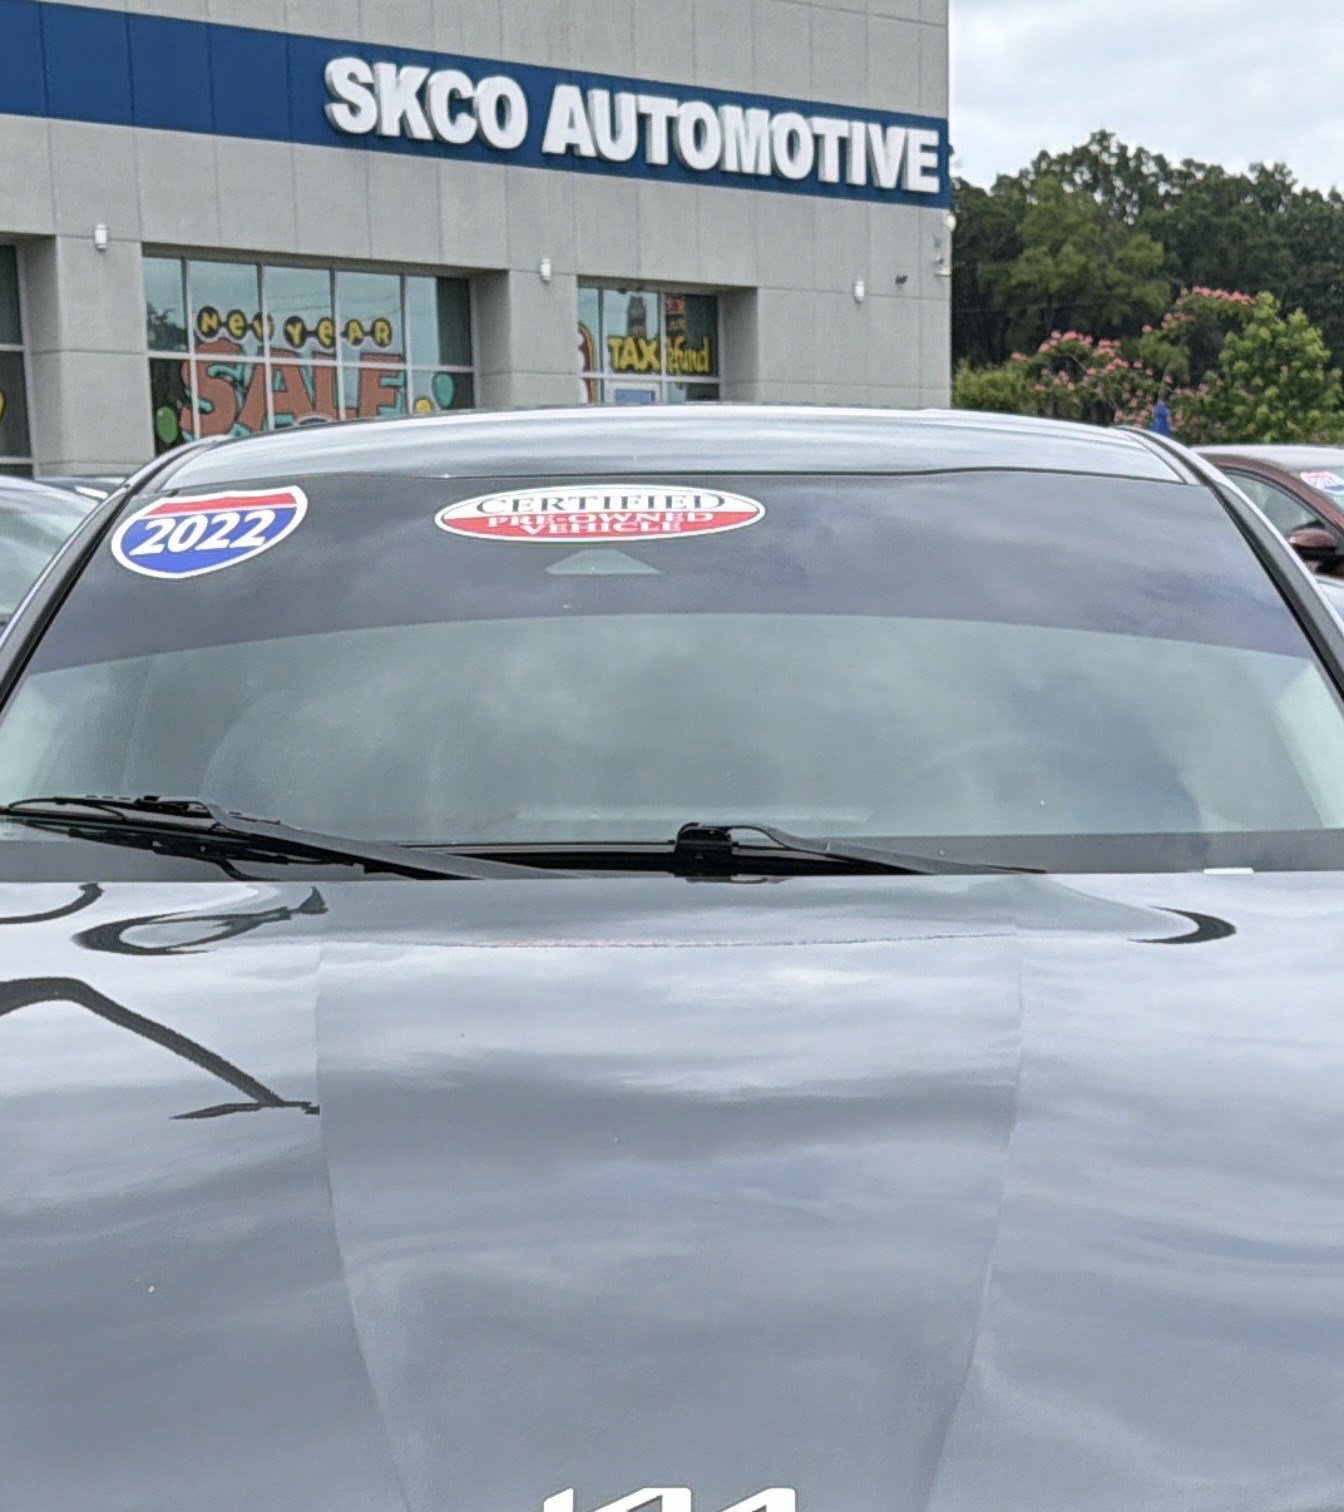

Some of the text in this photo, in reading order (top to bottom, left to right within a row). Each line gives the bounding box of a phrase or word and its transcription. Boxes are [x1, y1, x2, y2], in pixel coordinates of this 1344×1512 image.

[324, 56, 941, 194] SKCO AUTOMOTIVE
[608, 336, 662, 370] TAX
[181, 337, 405, 437] SALE
[476, 495, 725, 515] CERTIFIED
[487, 511, 713, 528] PRE-OWNED
[129, 509, 276, 556] 2022
[522, 520, 682, 535] VEHICLE
